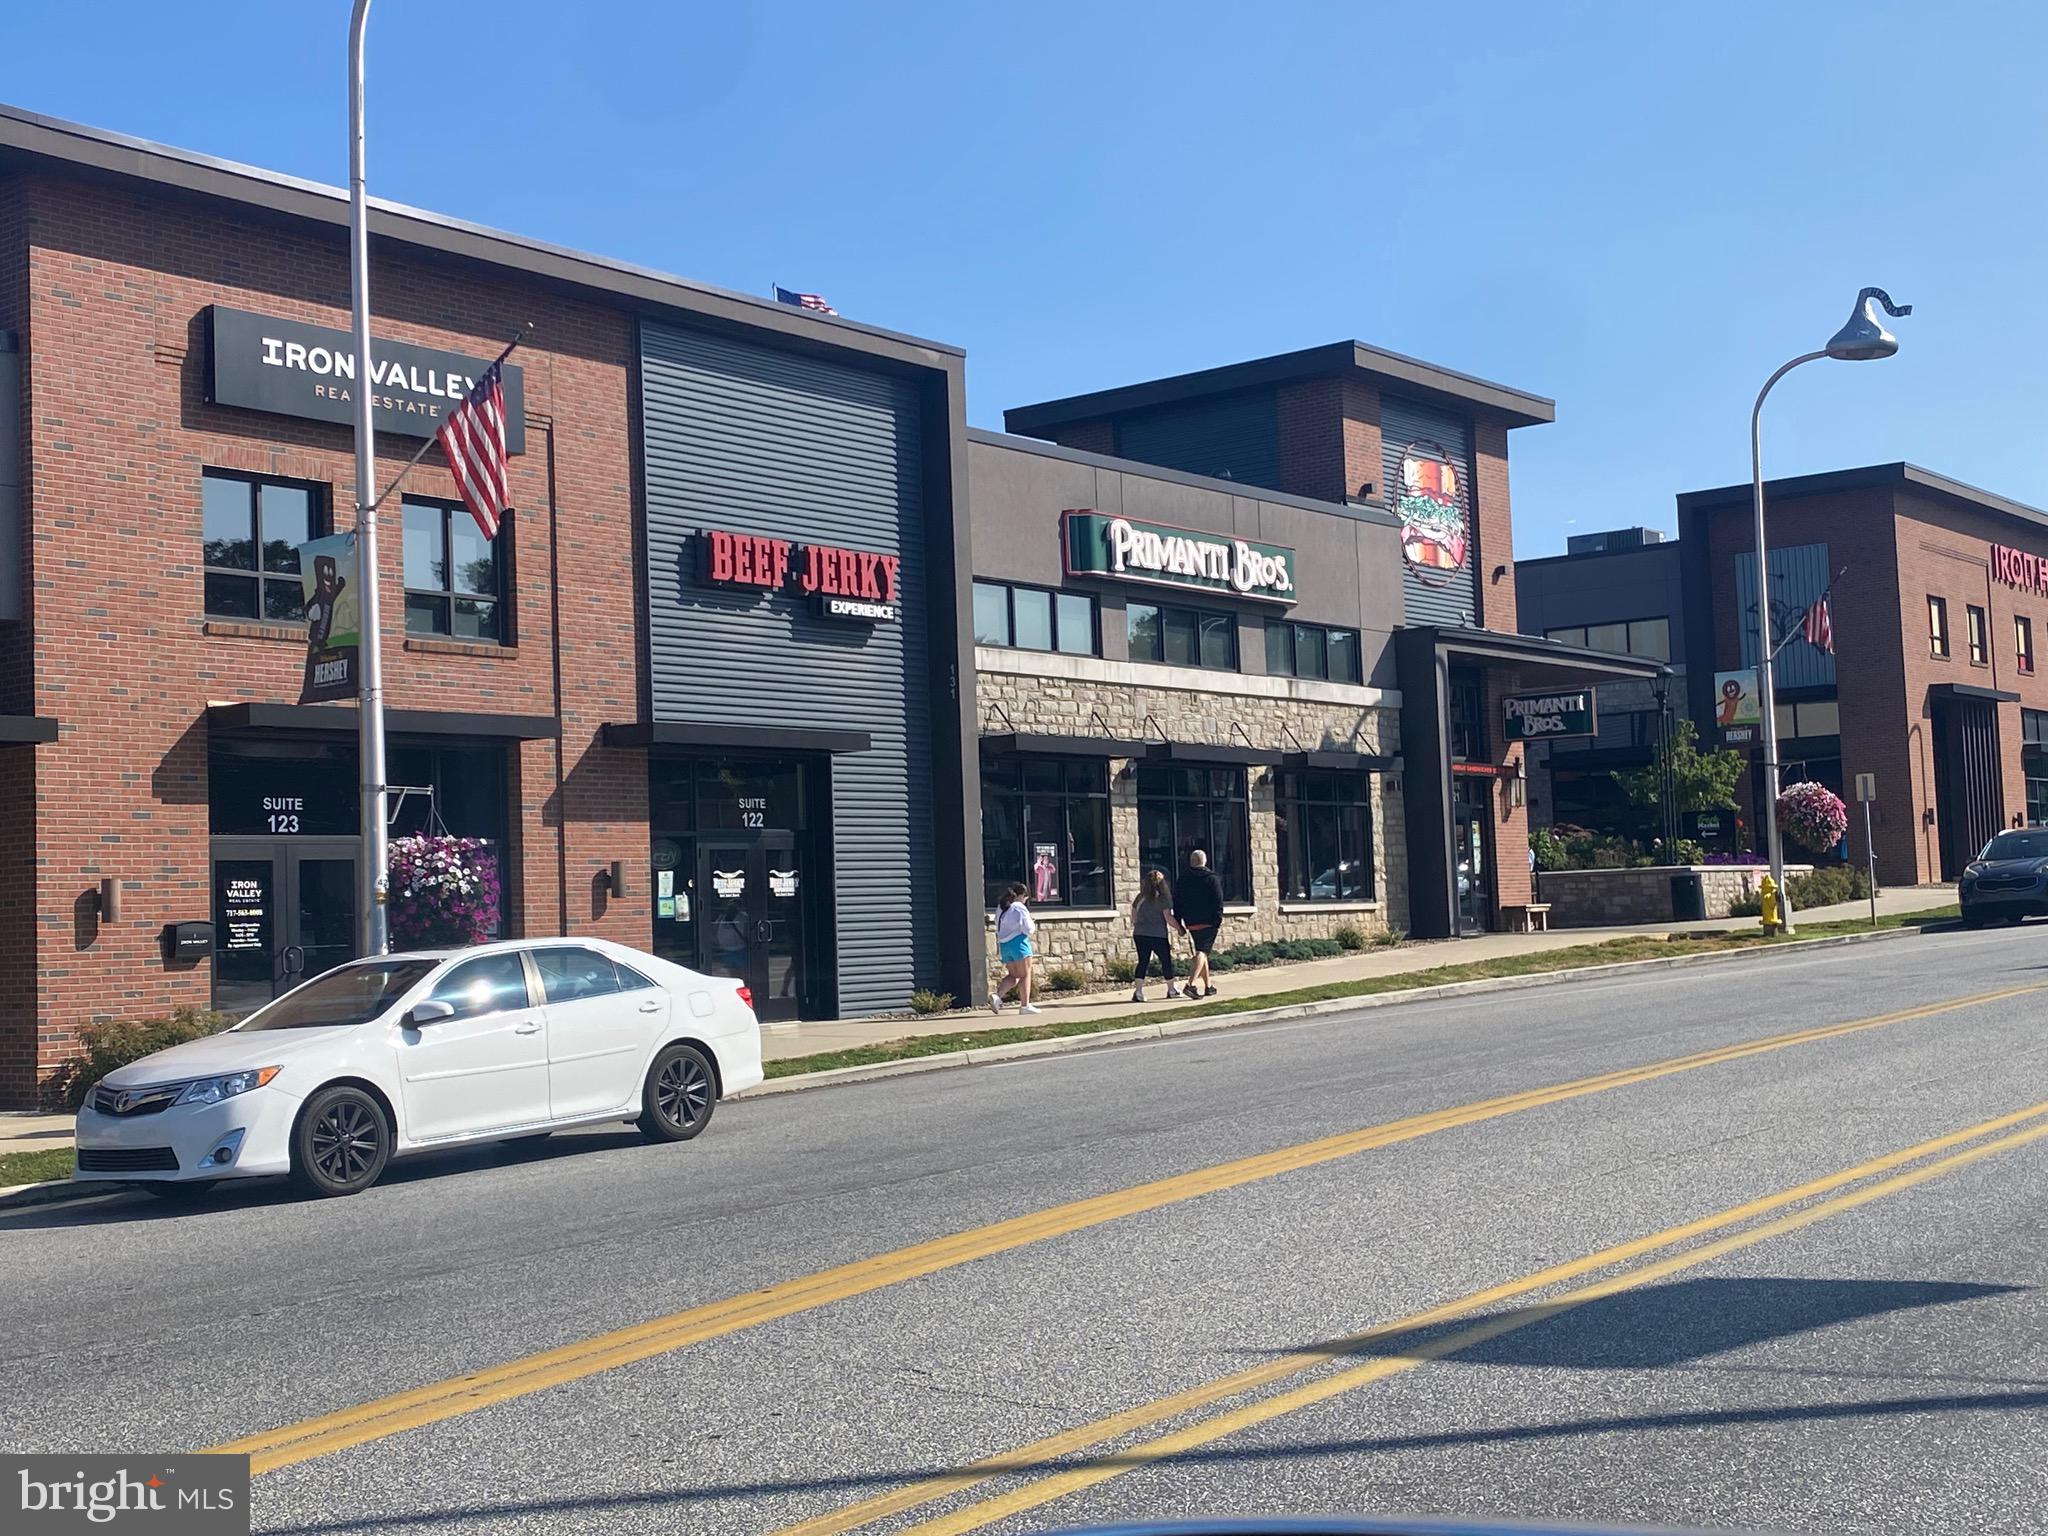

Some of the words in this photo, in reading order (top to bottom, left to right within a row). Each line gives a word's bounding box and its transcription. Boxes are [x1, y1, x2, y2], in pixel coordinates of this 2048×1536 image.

[261, 337, 355, 380] IRON
[315, 385, 351, 402] REA
[372, 394, 438, 417] ESTATE
[1109, 519, 1229, 581] PRIMANTI
[711, 530, 790, 587] BEEF
[803, 545, 899, 600] JERKY
[1992, 543, 2035, 588] IRON
[831, 600, 894, 619] EXPERIENCE
[313, 659, 348, 684] HERSHEY
[1504, 694, 1584, 720] PRIMANTI
[263, 797, 304, 810] SUITE
[738, 798, 767, 809] SUITE
[267, 815, 300, 833] 123
[742, 812, 764, 827] 122
[226, 890, 262, 898] VALLEY
[230, 880, 258, 889] IRON
